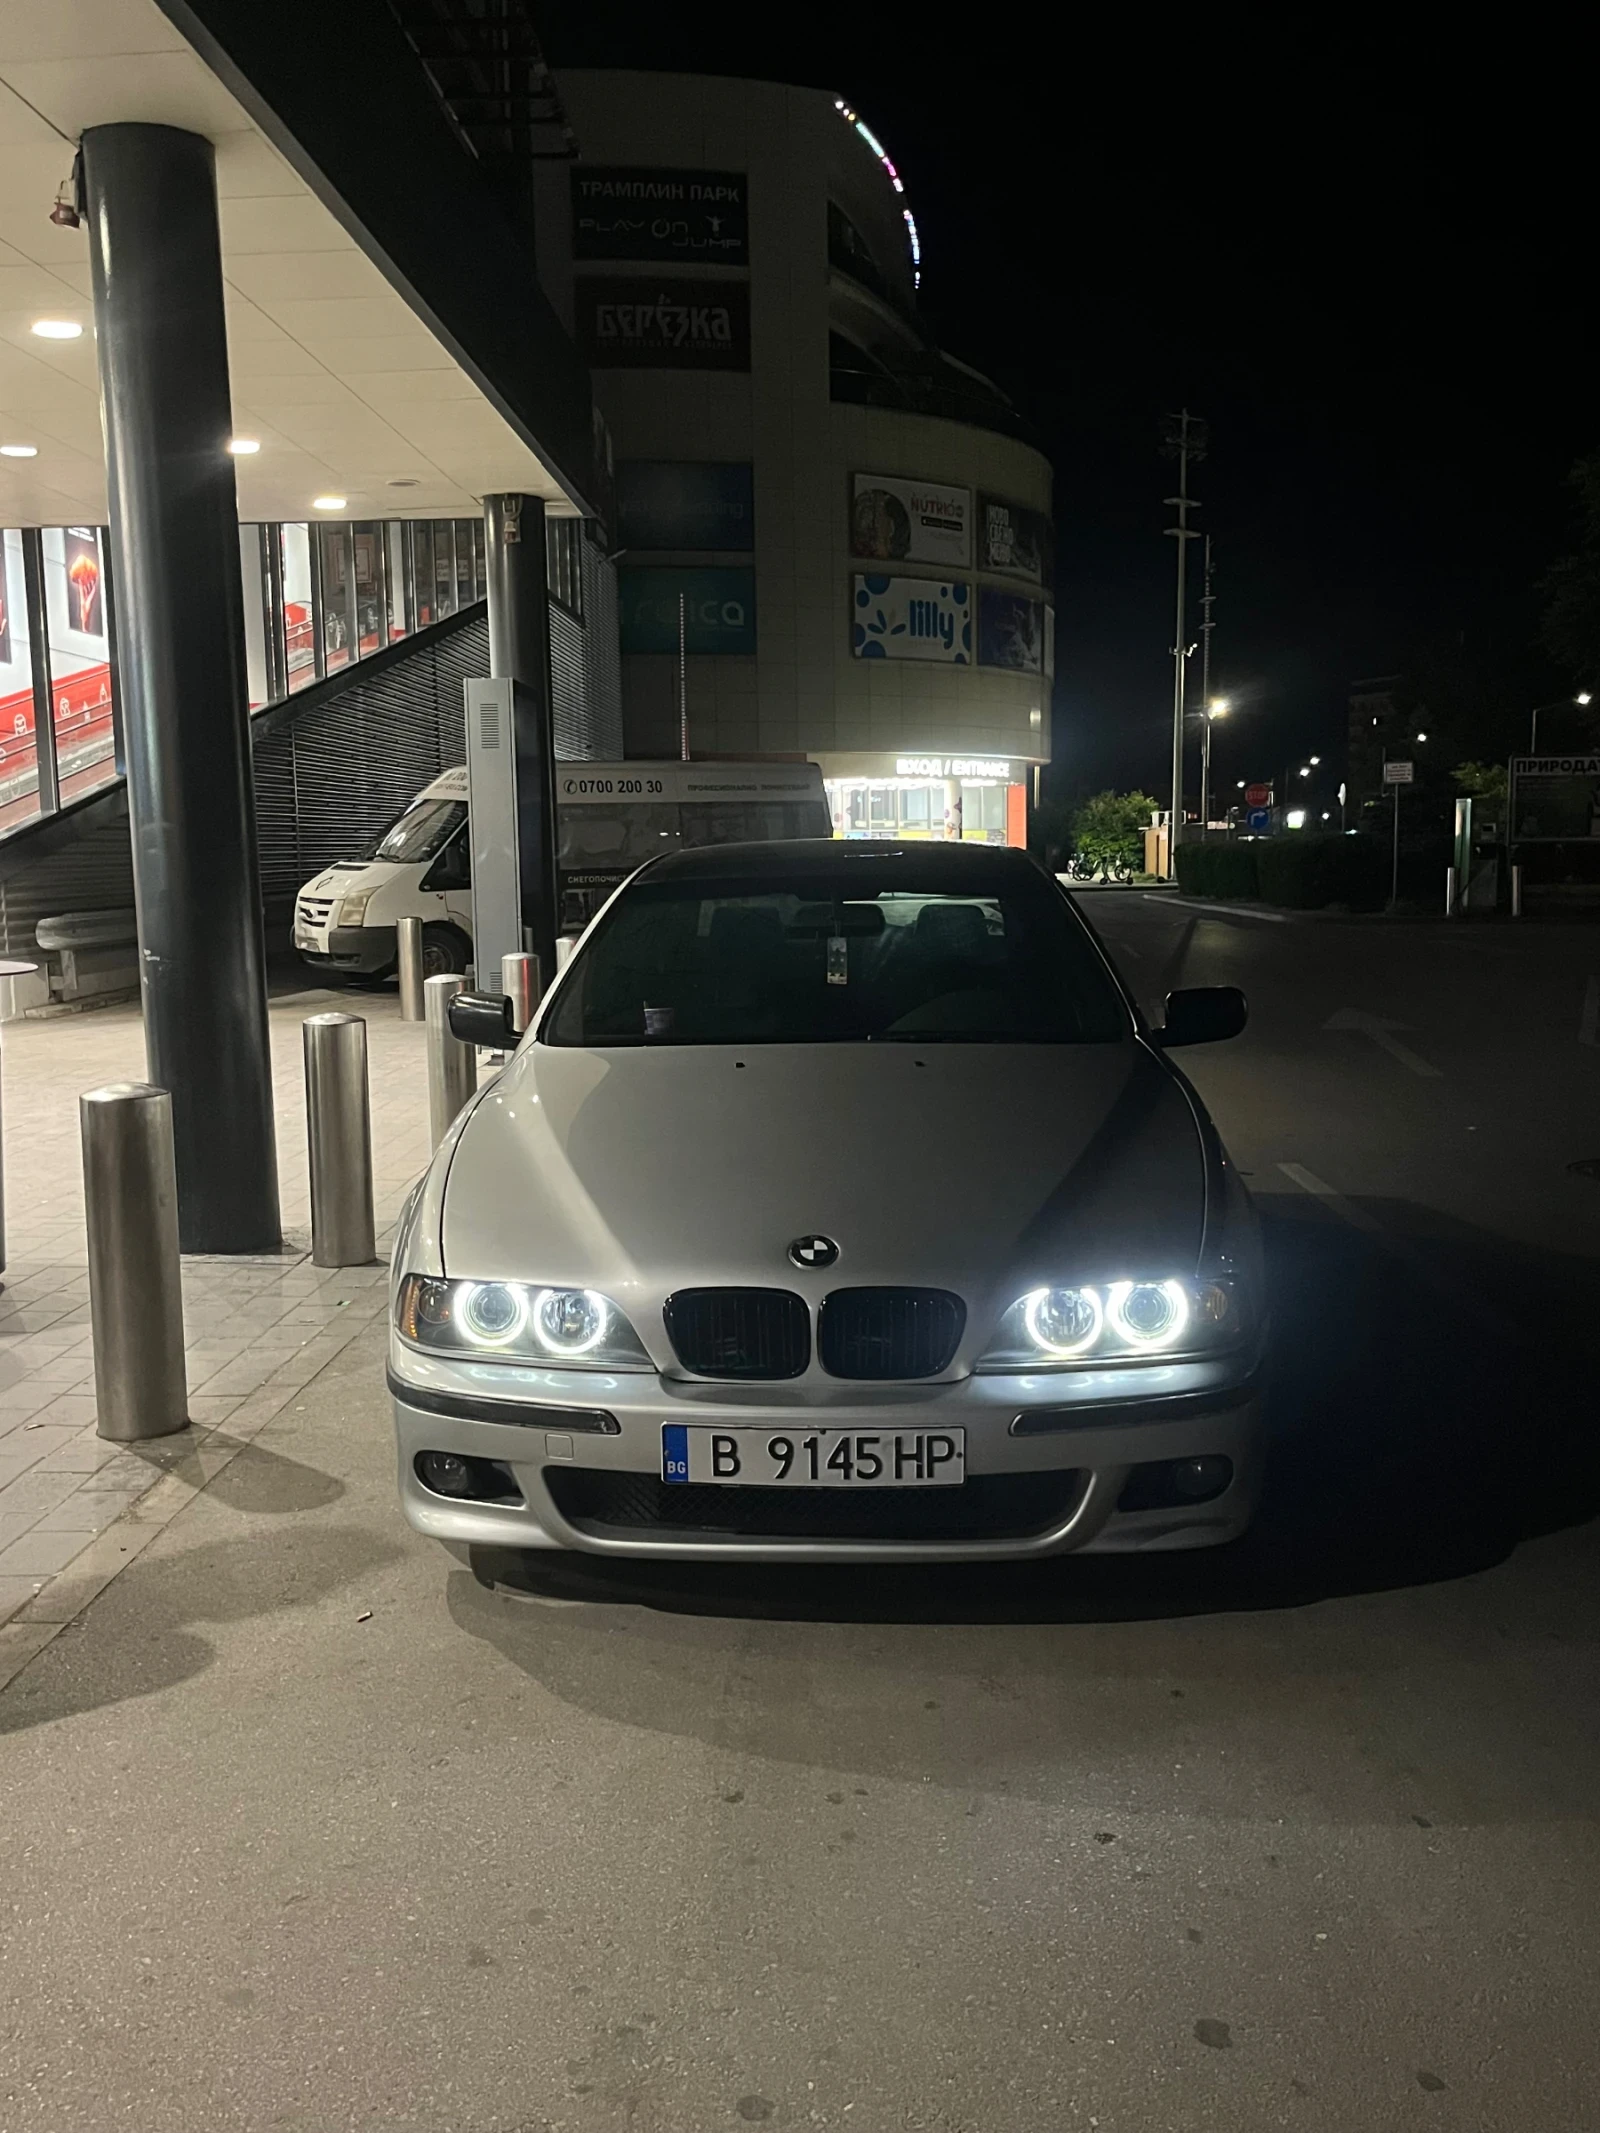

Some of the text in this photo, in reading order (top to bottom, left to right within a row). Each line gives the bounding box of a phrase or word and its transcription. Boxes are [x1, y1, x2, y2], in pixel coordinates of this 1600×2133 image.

[579, 181, 740, 202] ТРАМПЛИН ПАРК
[672, 238, 742, 249] JUMP
[909, 600, 954, 650] lilly
[896, 759, 942, 777] ВХОД
[1516, 760, 1600, 775] ПРИРОДА
[579, 779, 663, 794] 0700 200 30
[1248, 790, 1267, 800] STOP
[711, 1434, 956, 1480] B 9145 HP
[667, 1461, 686, 1474] BG
